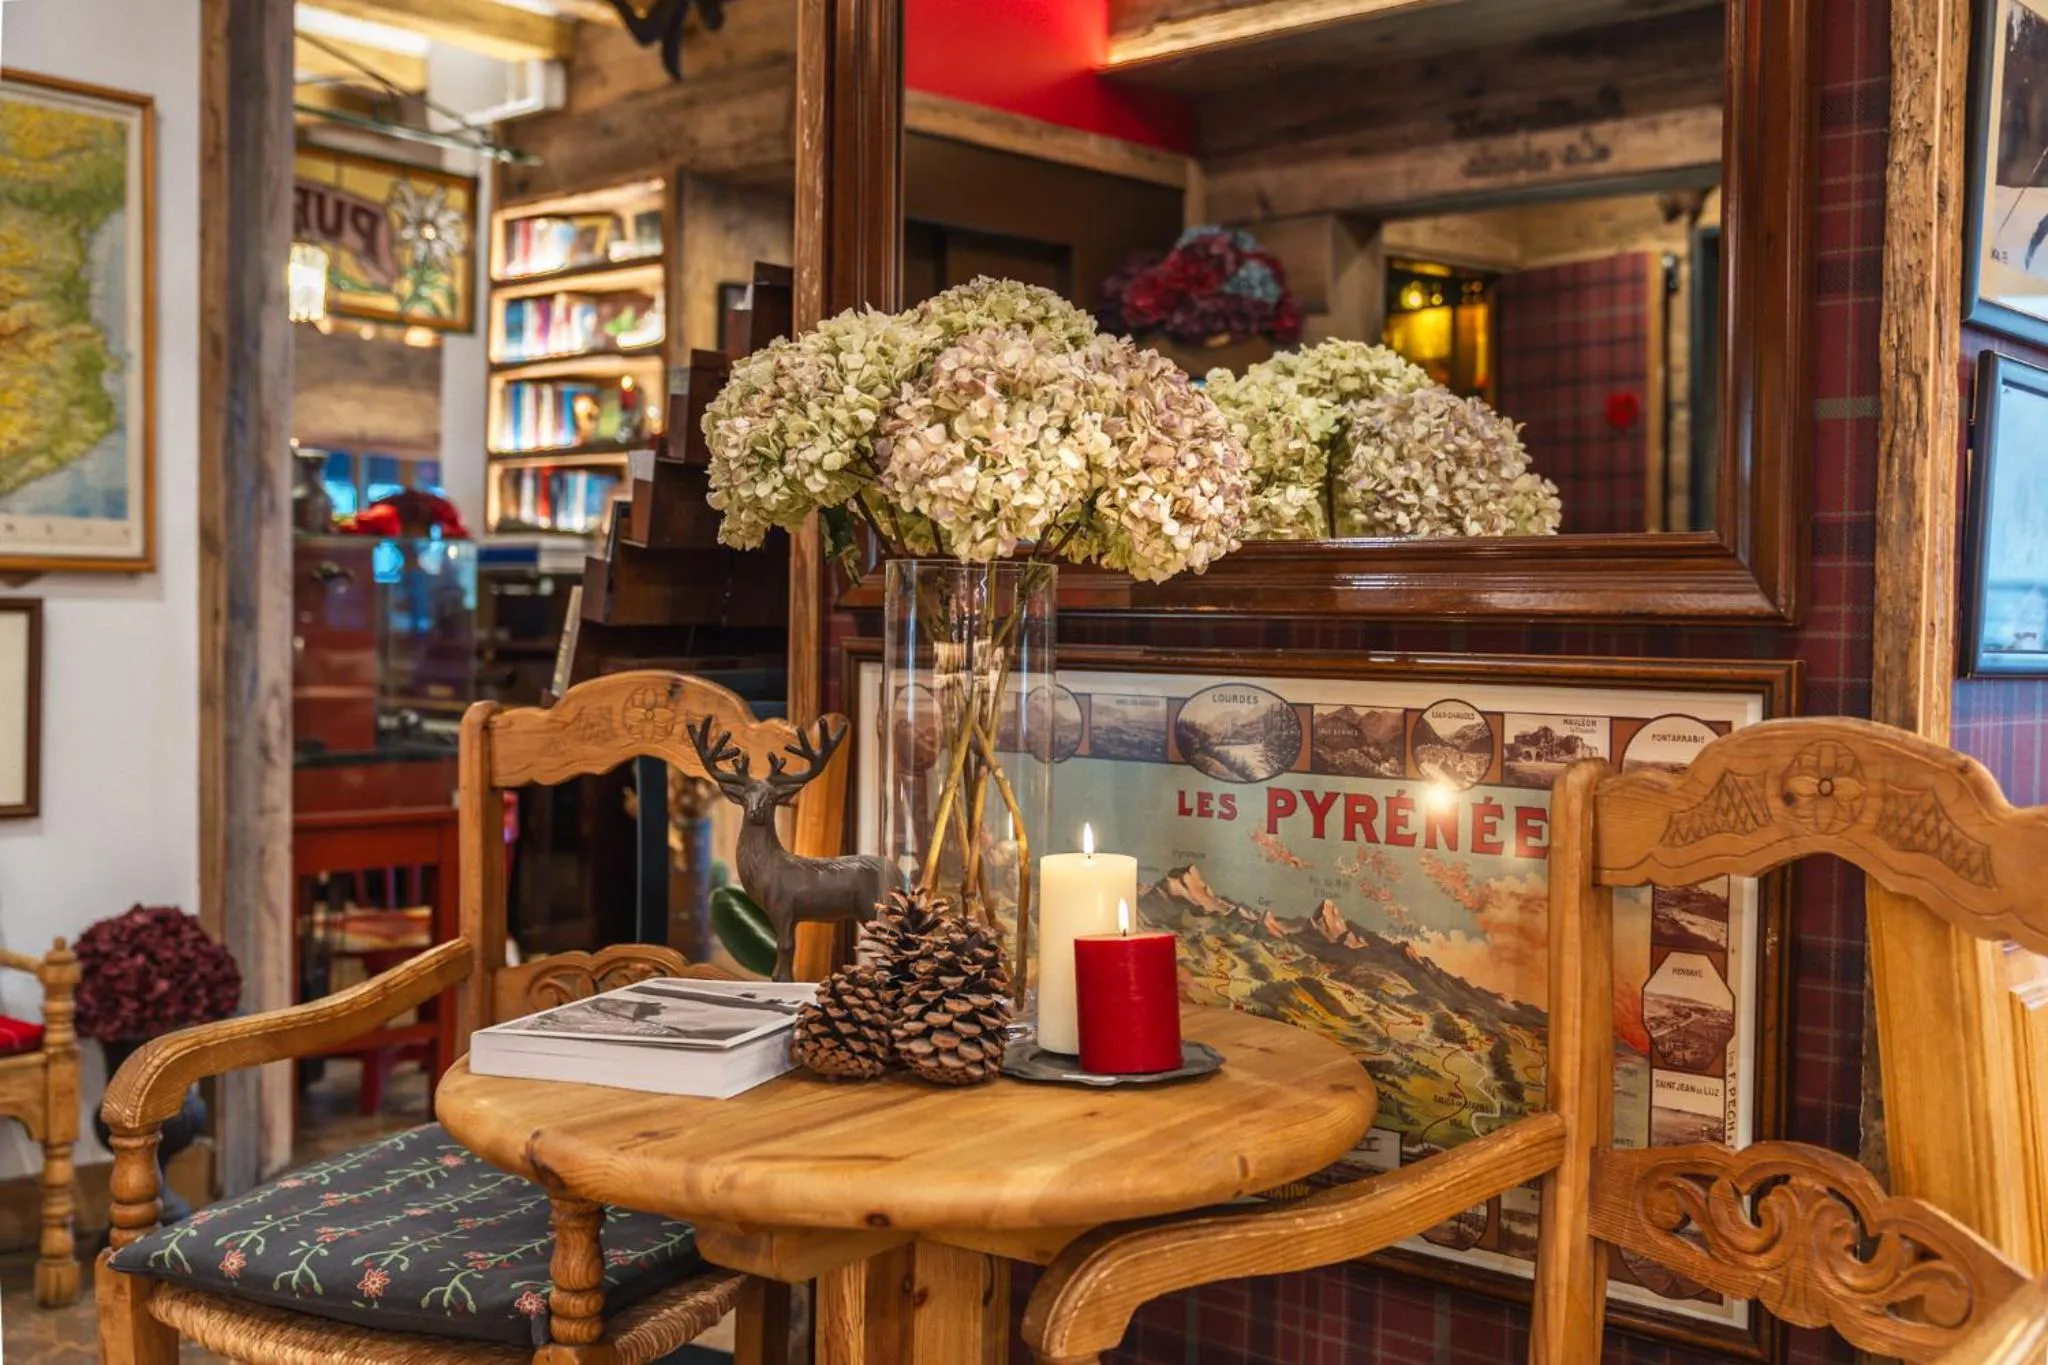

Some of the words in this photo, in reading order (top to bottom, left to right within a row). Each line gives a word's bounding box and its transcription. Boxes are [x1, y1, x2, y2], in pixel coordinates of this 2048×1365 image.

[1211, 693, 1259, 705] LOURDES
[1651, 732, 1706, 744] FONTARRABIE
[1177, 790, 1238, 821] LES
[1655, 1079, 1676, 1090] SAINT
[1676, 1082, 1697, 1093] JEAN
[1704, 1086, 1720, 1097] LUZ
